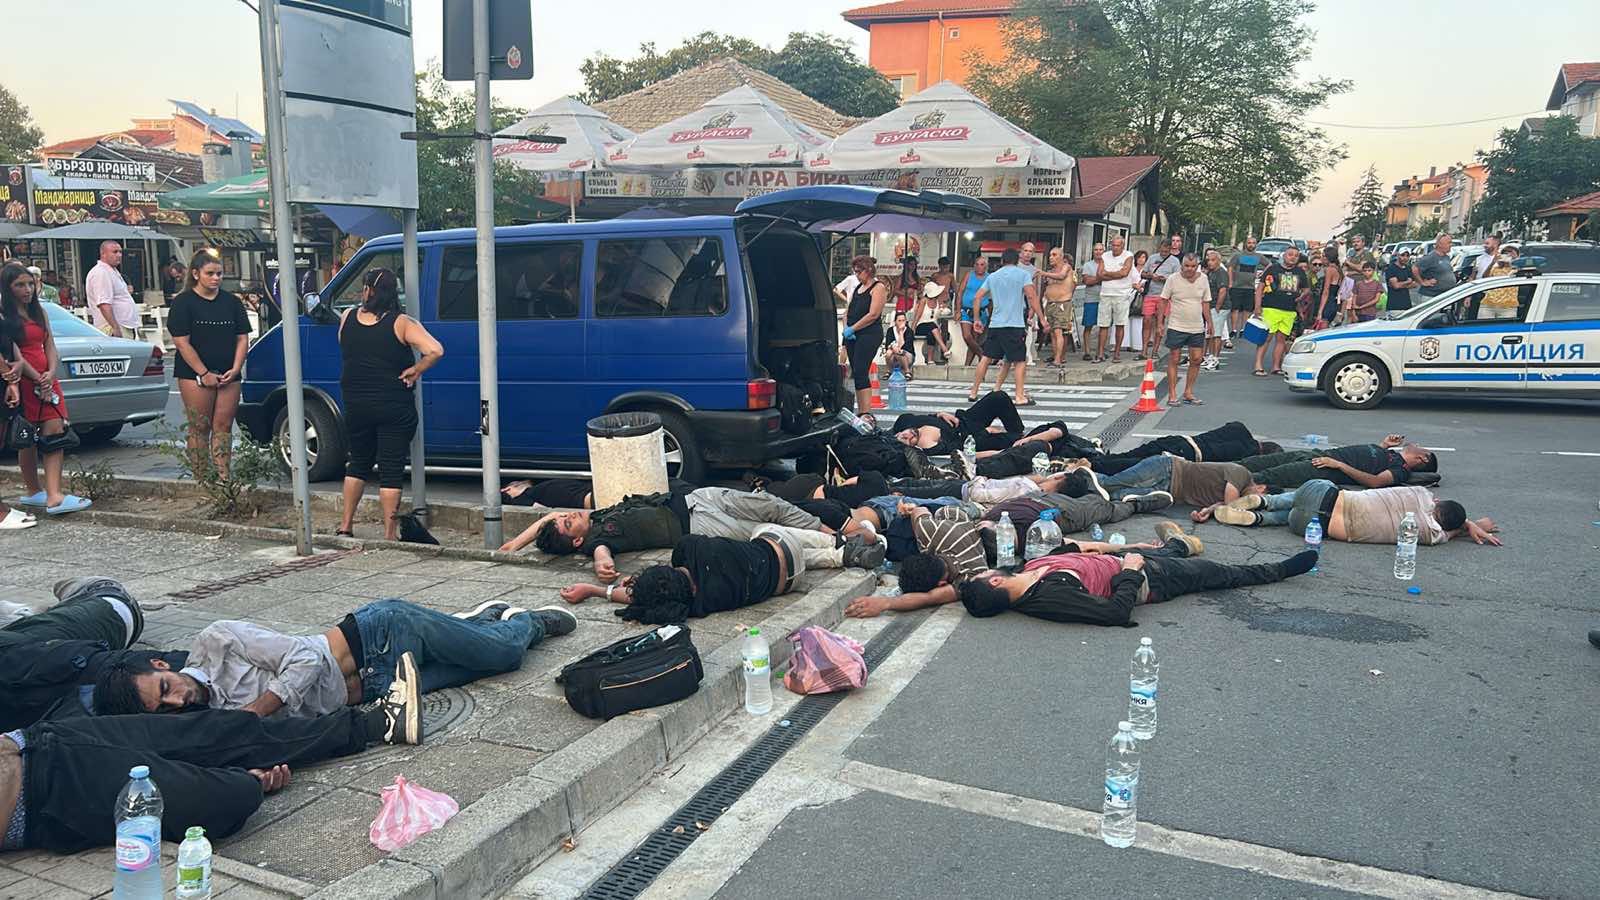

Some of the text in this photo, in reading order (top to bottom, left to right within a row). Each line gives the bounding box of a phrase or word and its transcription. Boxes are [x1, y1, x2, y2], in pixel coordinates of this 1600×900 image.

[880, 128, 963, 143] БУРГАСКО
[55, 159, 147, 176] БЪРЗО ХРАНЕНЕ
[724, 170, 849, 187] СКАРА БИРА
[0, 185, 10, 202] ца
[34, 190, 96, 206] Манджарница
[128, 190, 158, 202] Мандж
[1028, 187, 1065, 196] БУРГАСКО
[1455, 343, 1585, 362] ПОЛИЦИЯ
[79, 364, 86, 373] A
[89, 363, 110, 373] 1050
